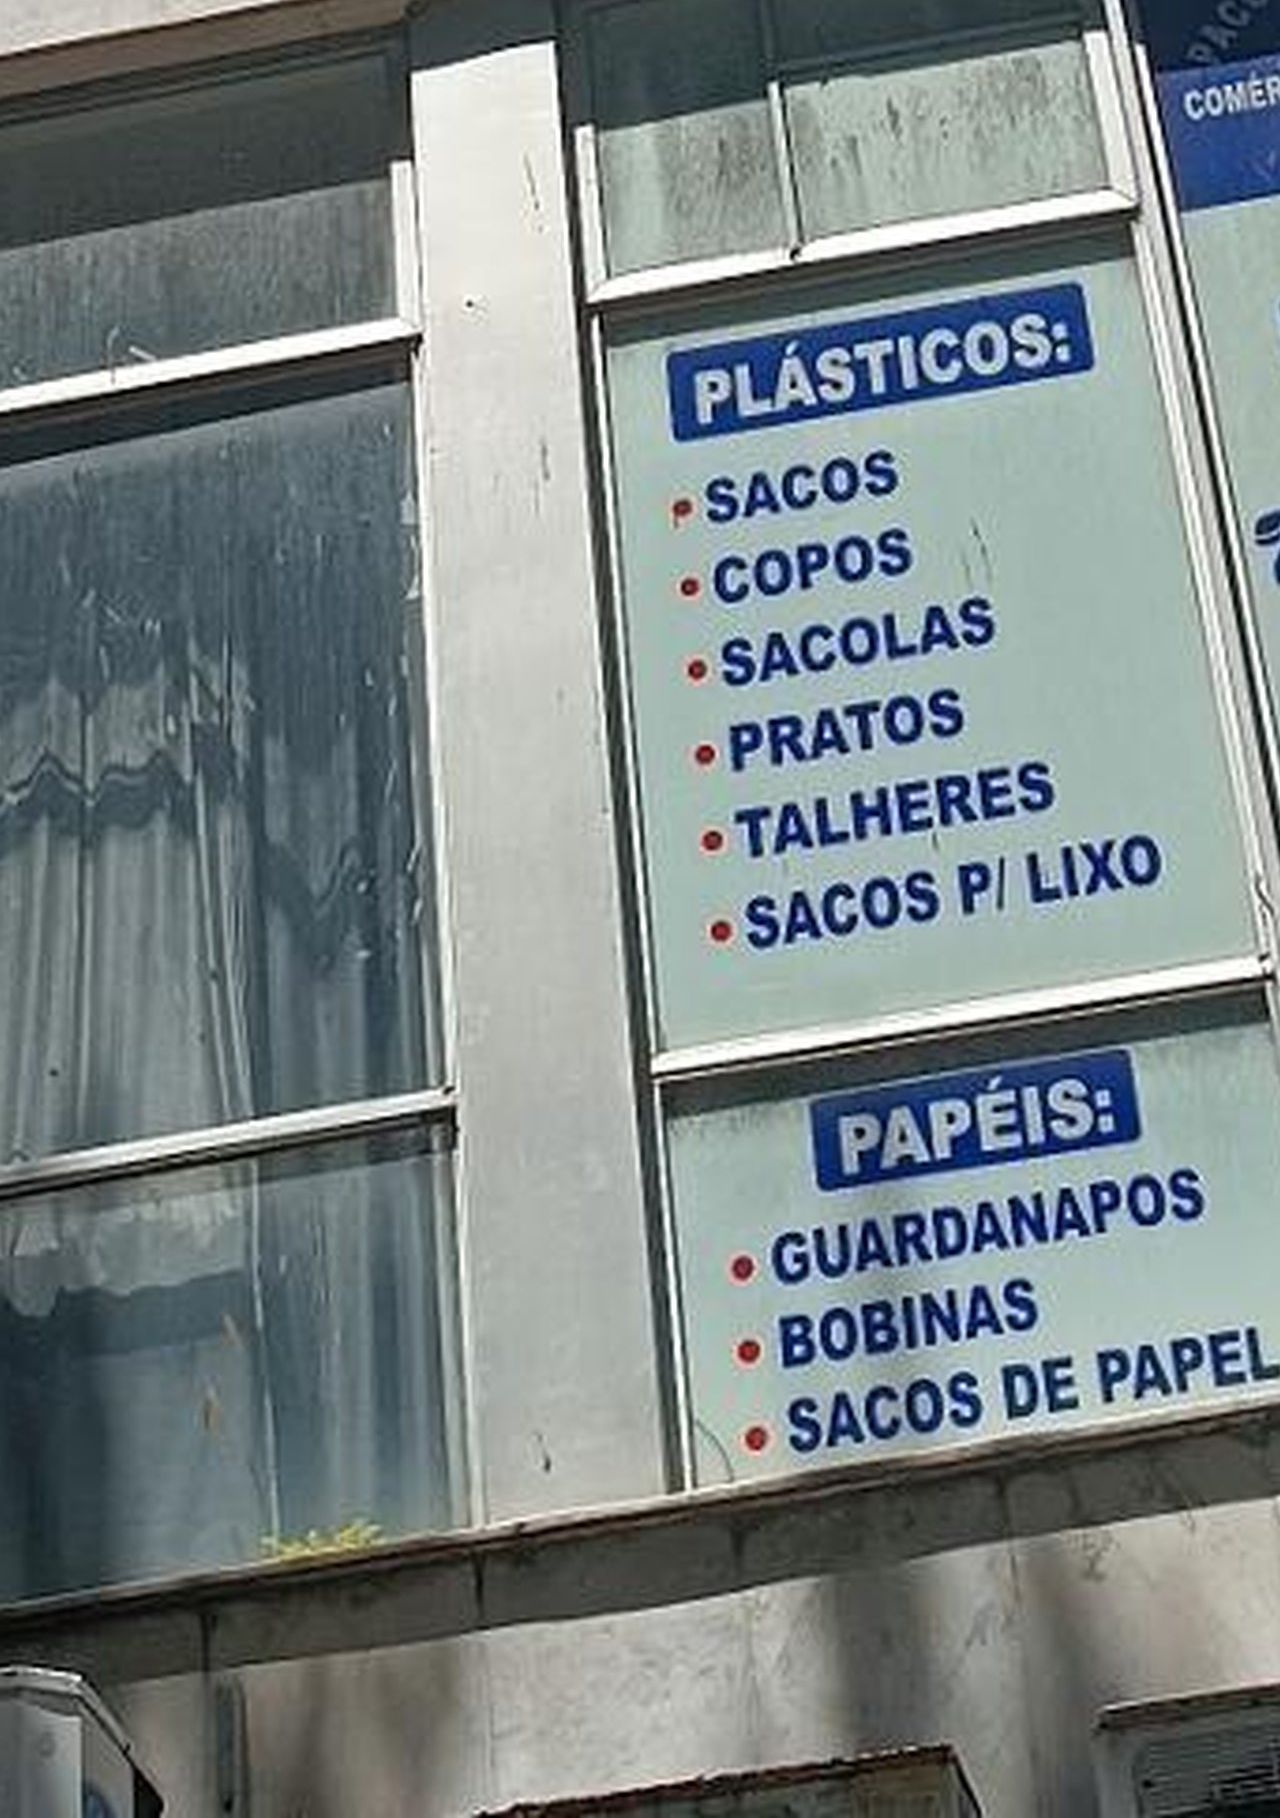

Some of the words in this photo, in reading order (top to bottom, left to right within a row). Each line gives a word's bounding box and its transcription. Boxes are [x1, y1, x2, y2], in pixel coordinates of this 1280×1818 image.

[694, 312, 1070, 426] PLÁSTICOS:
[705, 450, 899, 525] SACOS
[713, 528, 913, 604] COPOS
[721, 596, 995, 687] SACOLAS
[728, 688, 964, 772] PRATOS
[736, 762, 1054, 858] TALHERES
[745, 871, 940, 949] SACOS
[958, 857, 1007, 914] P/
[1027, 834, 1162, 904] LIXO
[838, 1077, 1116, 1176] PAPÉIS:
[771, 1168, 1204, 1284] GUARDANAPOS
[778, 1279, 1039, 1368] BOBINAS
[788, 1372, 983, 1453] SACOS
[1003, 1357, 1079, 1420] DE
